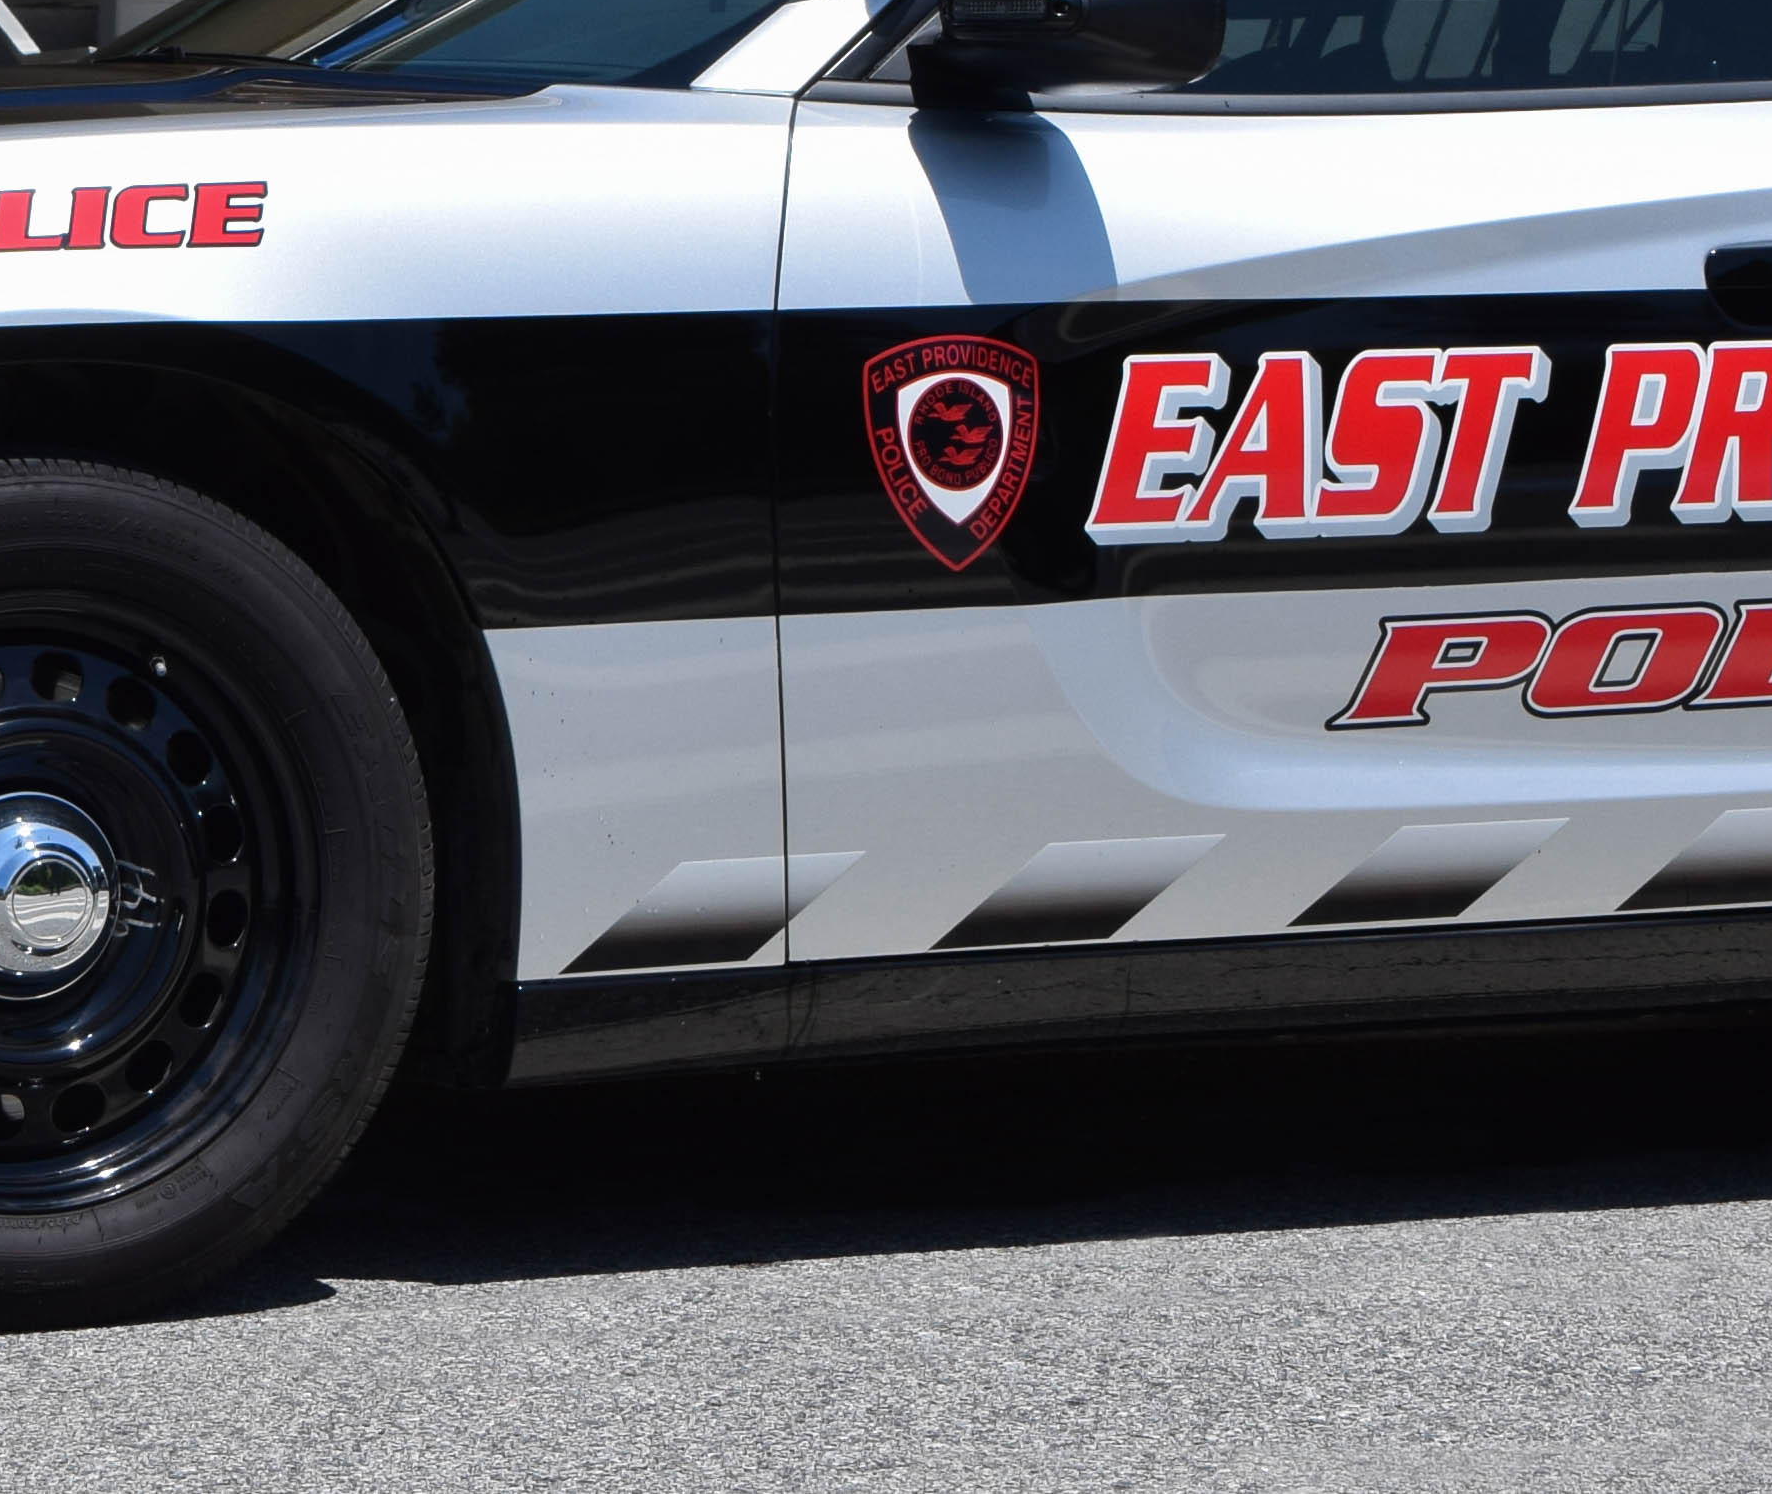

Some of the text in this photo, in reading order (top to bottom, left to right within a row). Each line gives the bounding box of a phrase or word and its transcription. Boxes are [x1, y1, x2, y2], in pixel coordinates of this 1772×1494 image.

[870, 343, 1033, 395] EAST PROVIDENCE
[914, 379, 998, 426] RHODE ISLAND
[875, 425, 929, 522] POLICE
[969, 394, 1033, 540] DEPARTMENT
[1086, 346, 1551, 545] EAST
